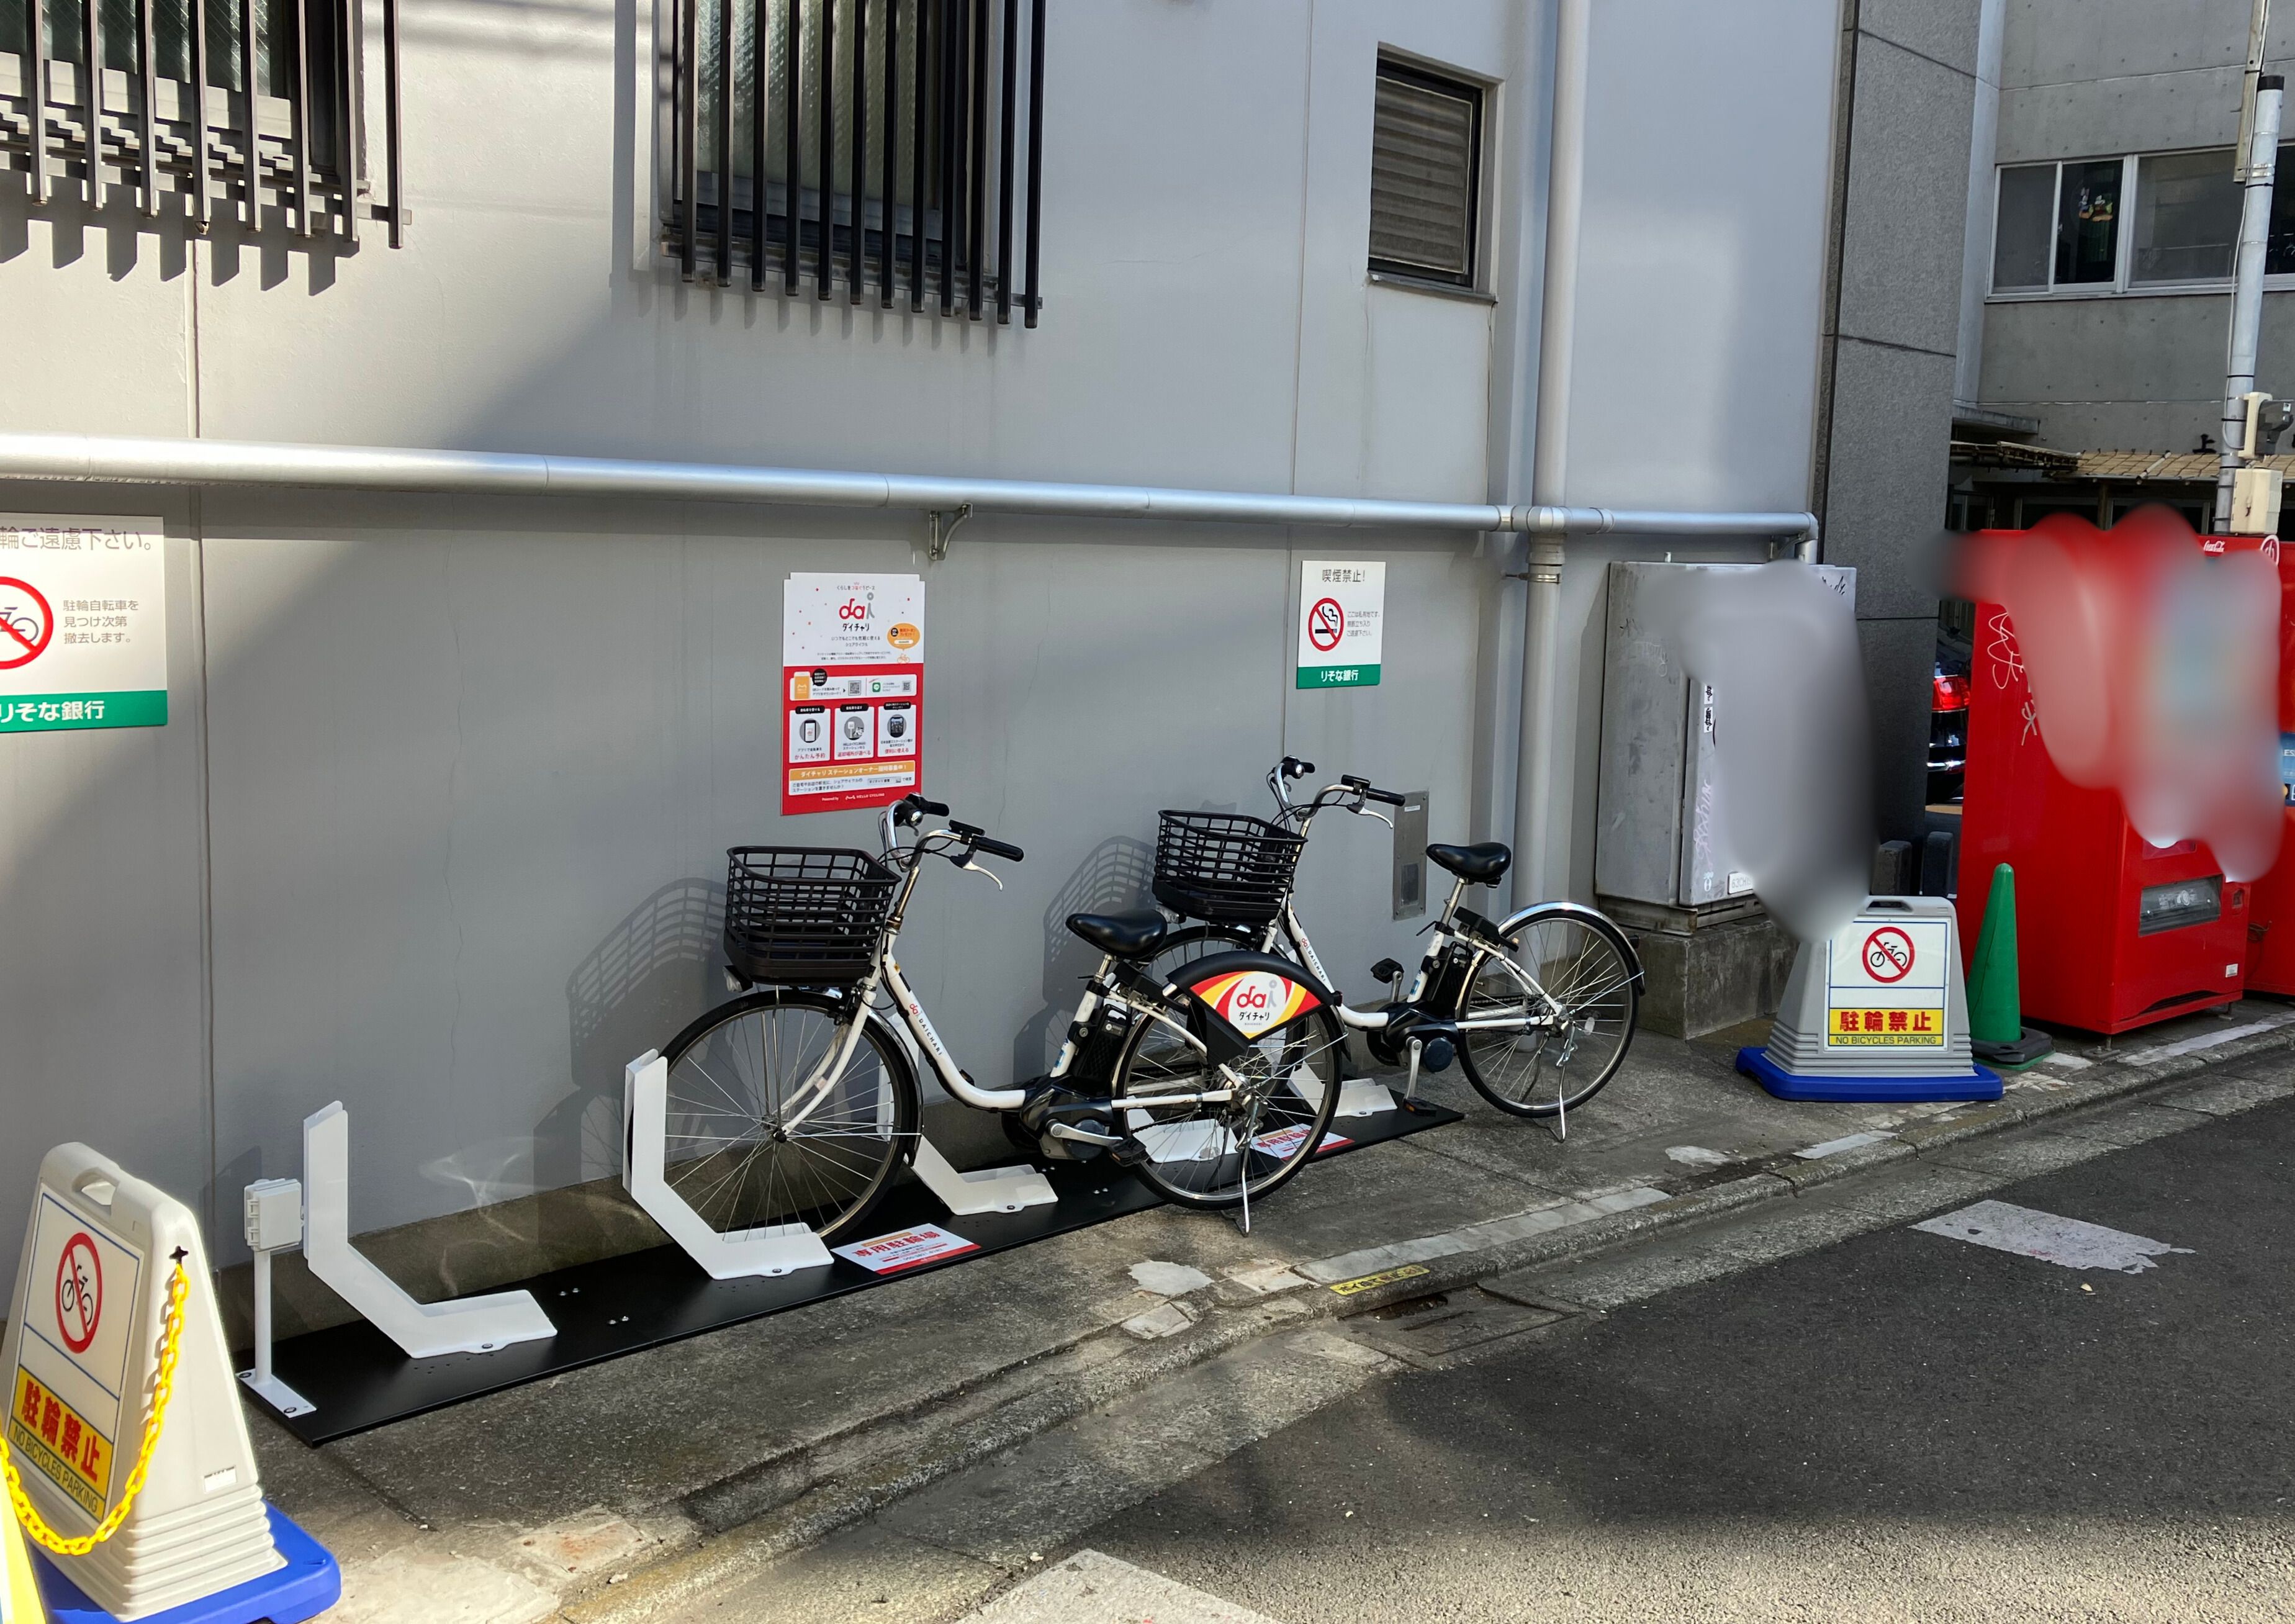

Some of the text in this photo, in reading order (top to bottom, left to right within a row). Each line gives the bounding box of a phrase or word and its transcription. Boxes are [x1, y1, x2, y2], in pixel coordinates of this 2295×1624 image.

[2203, 540, 2225, 552] Coca-Cola
[63, 600, 139, 611] 駐輪自転車を
[63, 616, 128, 628] 見つけ次第
[842, 623, 870, 632] ダイチャリ
[64, 632, 131, 644] 撤去します。
[1320, 670, 1359, 682] りそな銀行
[0, 700, 105, 723] りそな銀行
[1308, 950, 1326, 981] DAICHARI
[1239, 1011, 1270, 1021] ダイチャリ
[1839, 1011, 1932, 1032] 駐輪禁止
[919, 1018, 942, 1055] DAICHARI
[1835, 1036, 1936, 1044] NO BICYCLES PARKING
[21, 1378, 101, 1484] 駐輪禁止
[14, 1425, 98, 1513] NO BICYCLES PARKING
